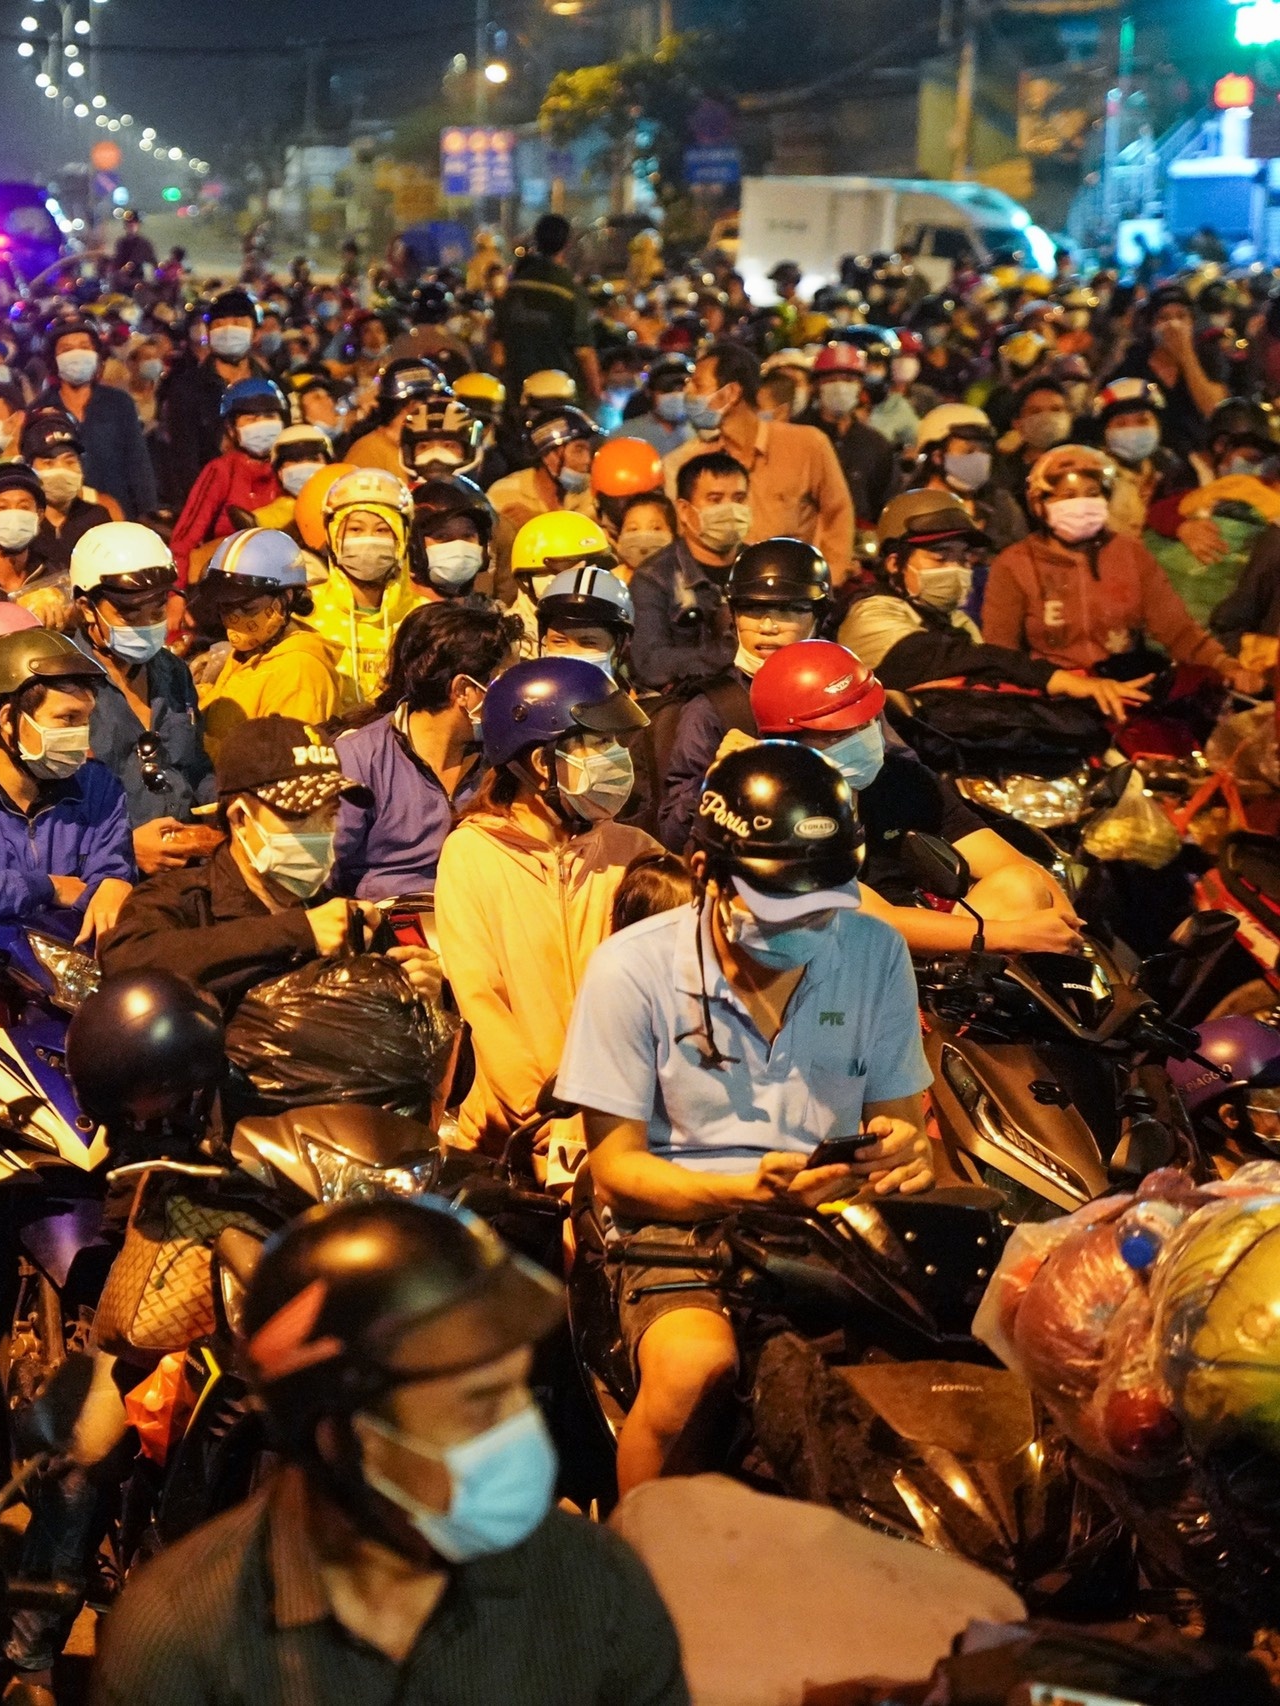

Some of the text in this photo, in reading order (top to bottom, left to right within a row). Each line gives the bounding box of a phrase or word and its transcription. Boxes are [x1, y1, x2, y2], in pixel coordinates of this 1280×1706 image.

[699, 789, 751, 838] Paris
[1062, 982, 1094, 993] HOND
[1186, 1063, 1232, 1092] PIAGGO
[931, 1383, 983, 1393] HONDA
